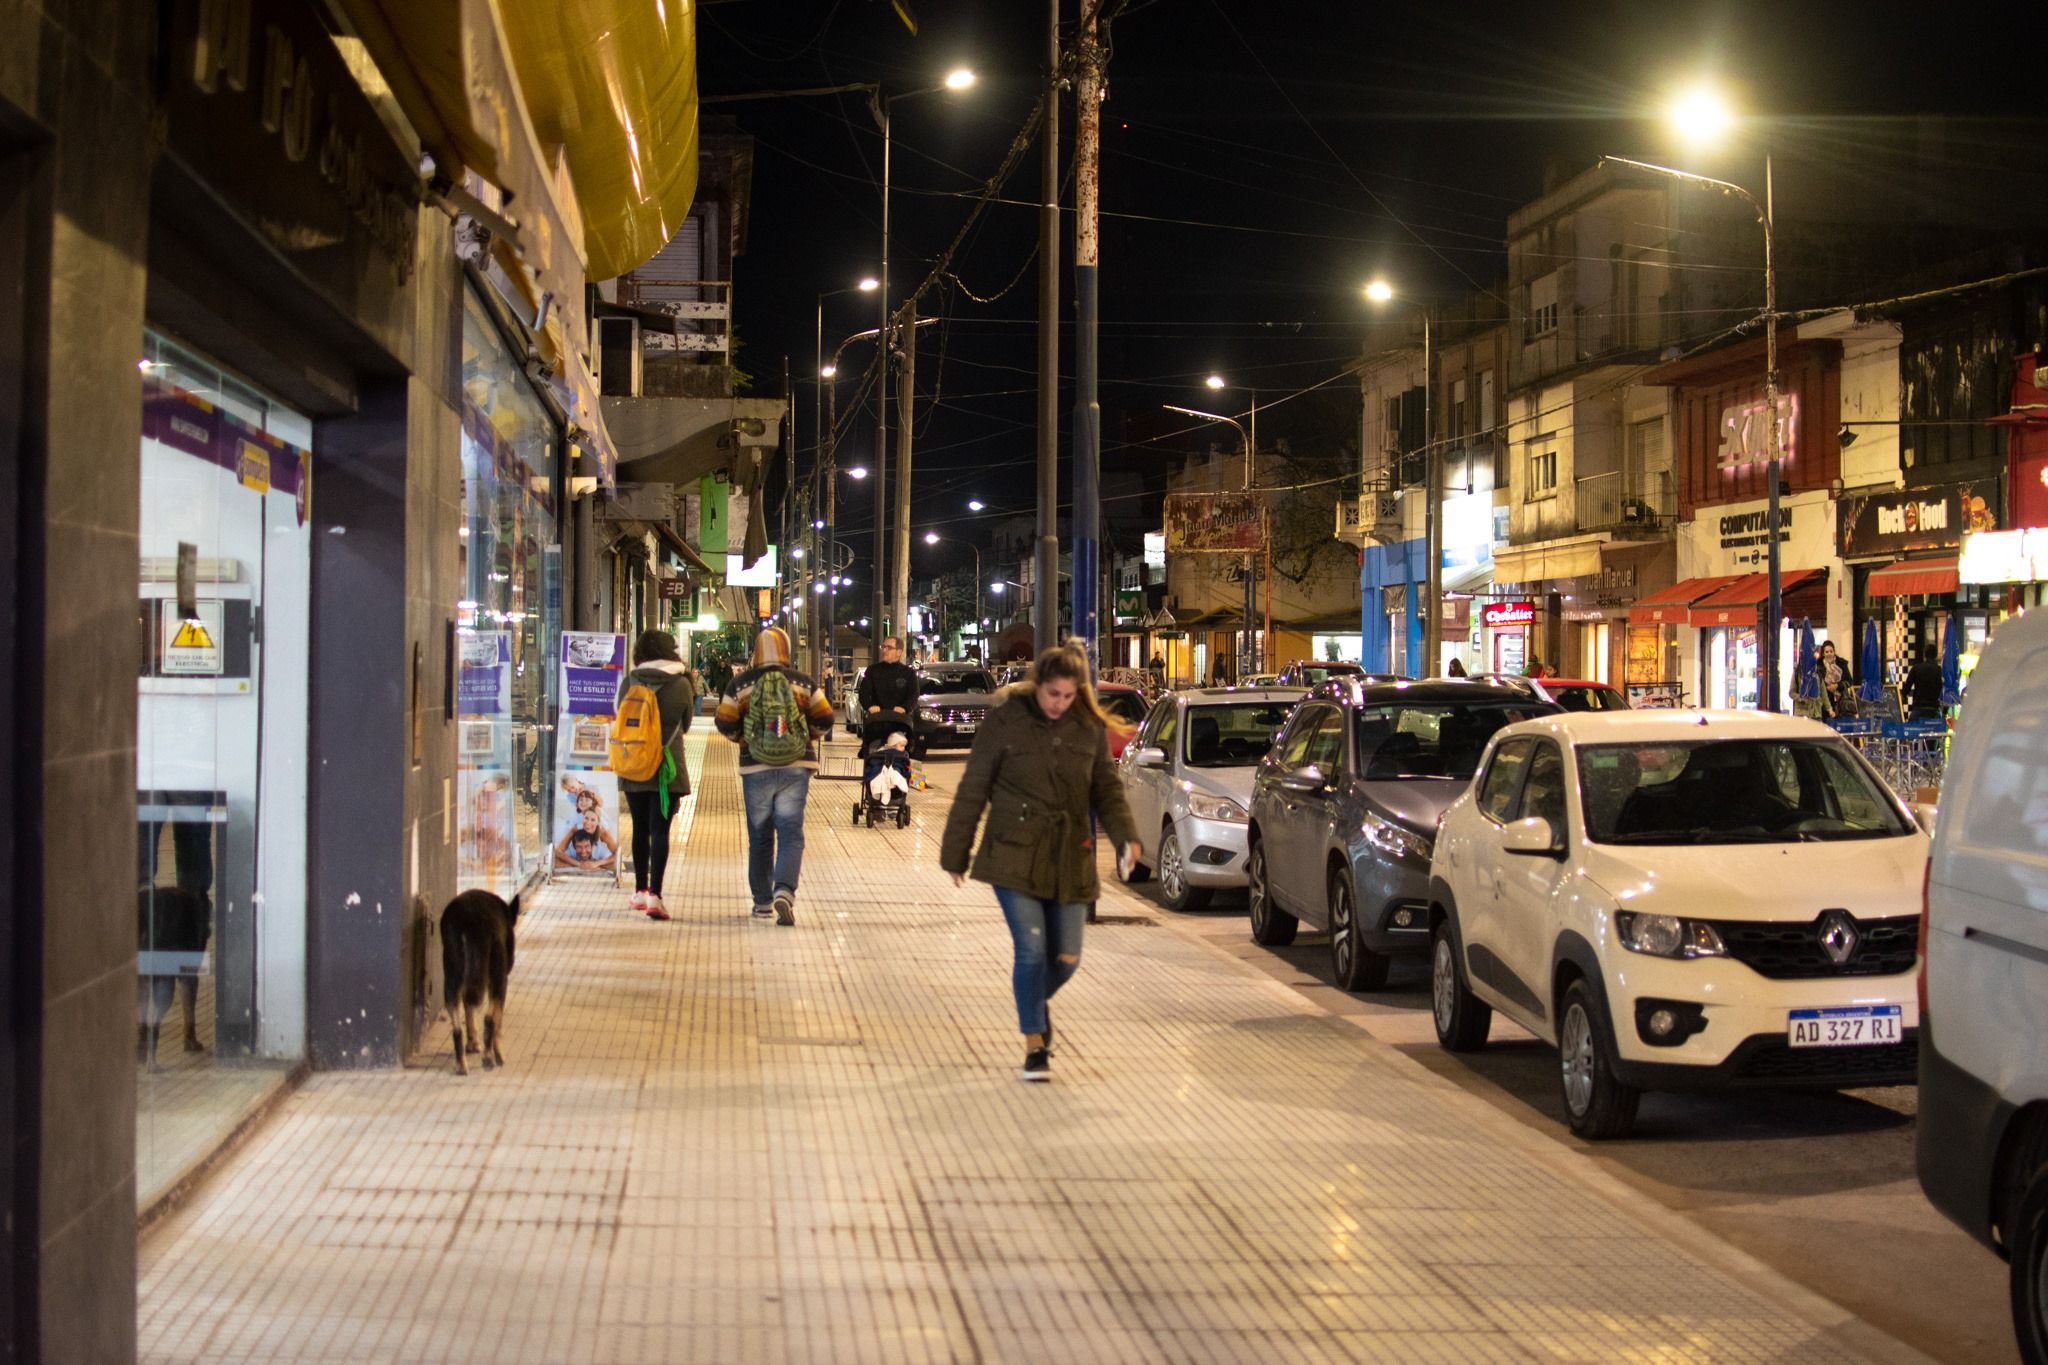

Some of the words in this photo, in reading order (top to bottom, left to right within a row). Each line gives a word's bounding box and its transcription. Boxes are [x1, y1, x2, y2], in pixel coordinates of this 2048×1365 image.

[1720, 507, 1792, 535] COMPUTACON
[1877, 504, 1906, 534] Rock
[1918, 499, 1947, 531] Food
[1603, 564, 1634, 588] Manuel
[1796, 1021, 1820, 1042] AD
[1827, 1019, 1864, 1041] 327
